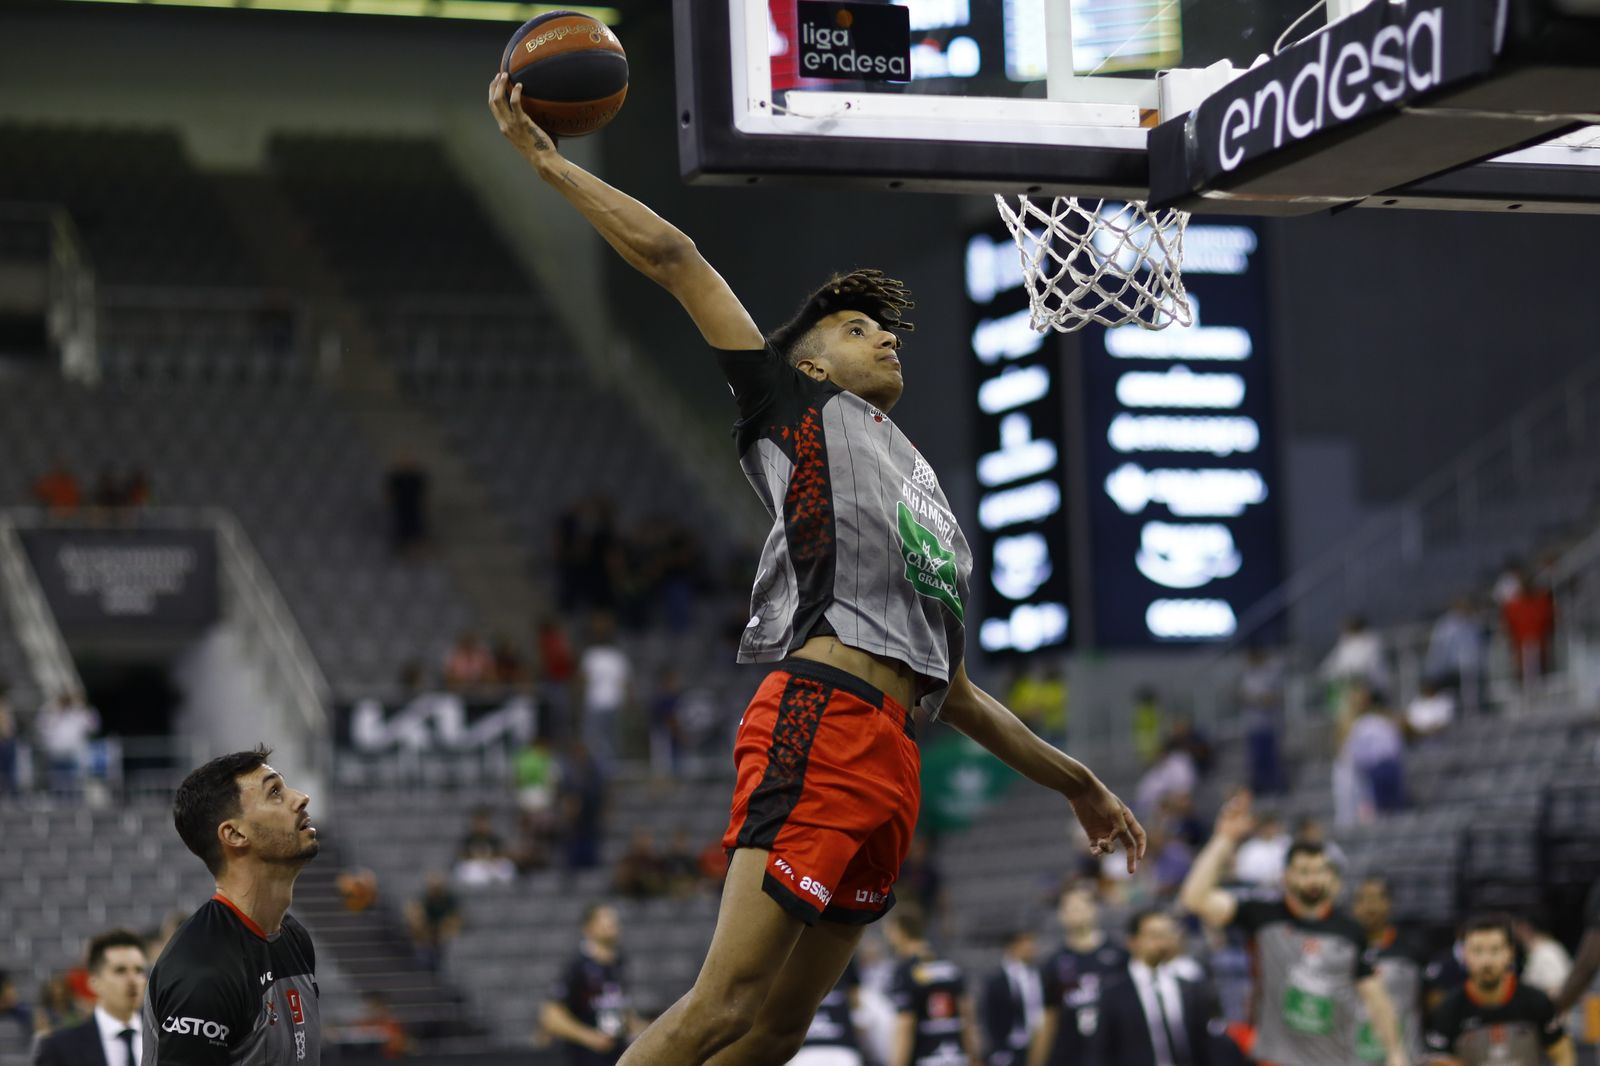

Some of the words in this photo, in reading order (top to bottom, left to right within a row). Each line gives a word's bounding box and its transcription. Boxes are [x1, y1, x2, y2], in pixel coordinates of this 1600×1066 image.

[803, 22, 848, 49] liga
[804, 49, 905, 74] endesa
[1219, 7, 1442, 171] endesa
[902, 482, 955, 547] ALHAMBRA
